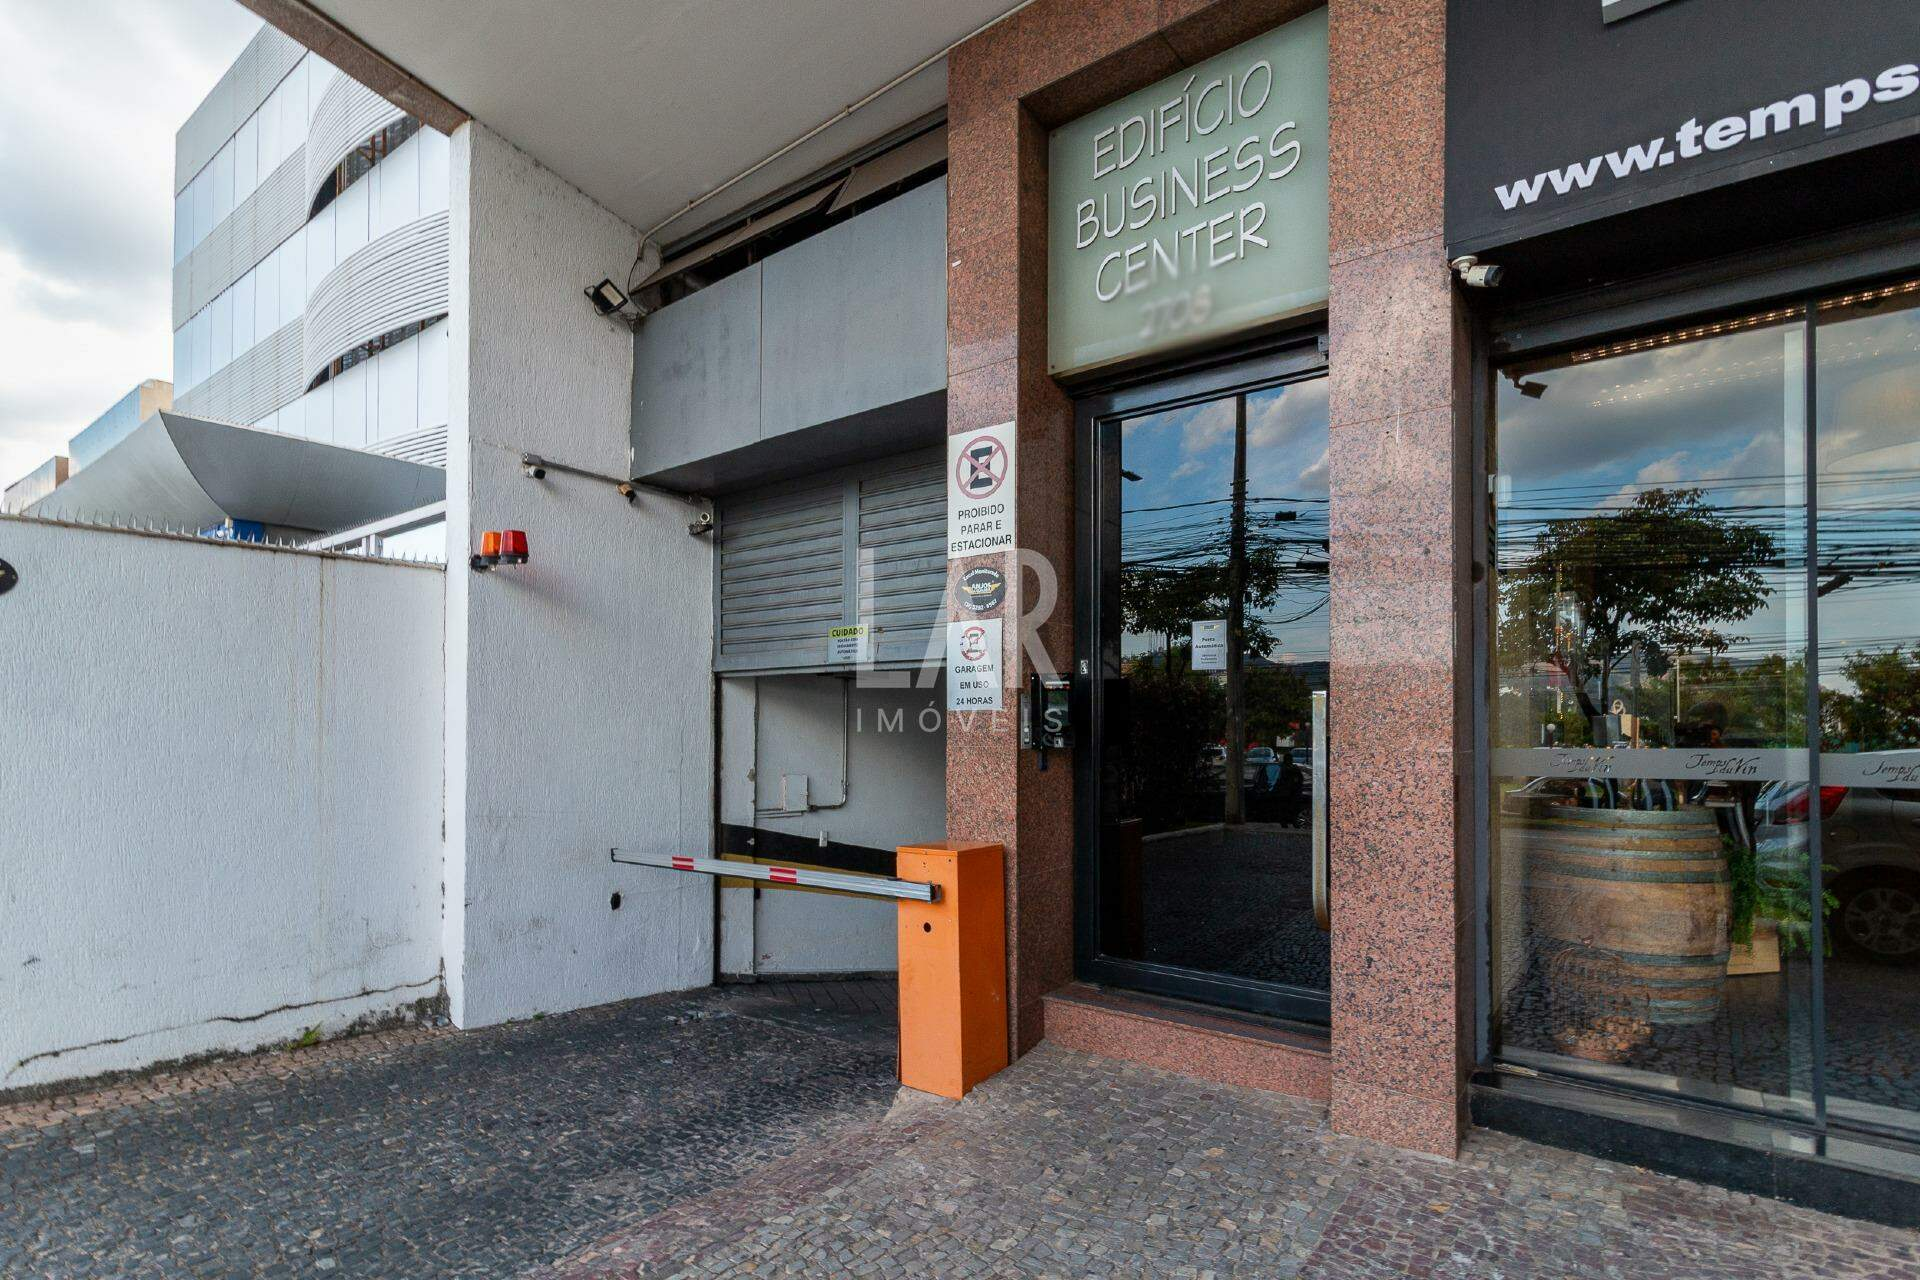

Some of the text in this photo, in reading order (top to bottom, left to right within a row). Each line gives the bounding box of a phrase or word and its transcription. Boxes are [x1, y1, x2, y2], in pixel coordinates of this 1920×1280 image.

[1093, 60, 1273, 180] EDIFÍCIO
[1494, 63, 1920, 211] www.temps
[1076, 121, 1301, 250] BUSINESS
[1096, 201, 1269, 302] CENTER
[958, 503, 1005, 520] PROIBIDO
[961, 519, 1002, 535] PARAR E
[951, 534, 1012, 552] ESTACIONAR
[832, 627, 864, 637] CUIDADO
[954, 664, 994, 674] GARAGEM
[959, 680, 990, 690] EM USO
[956, 696, 994, 705] 24 HORAS
